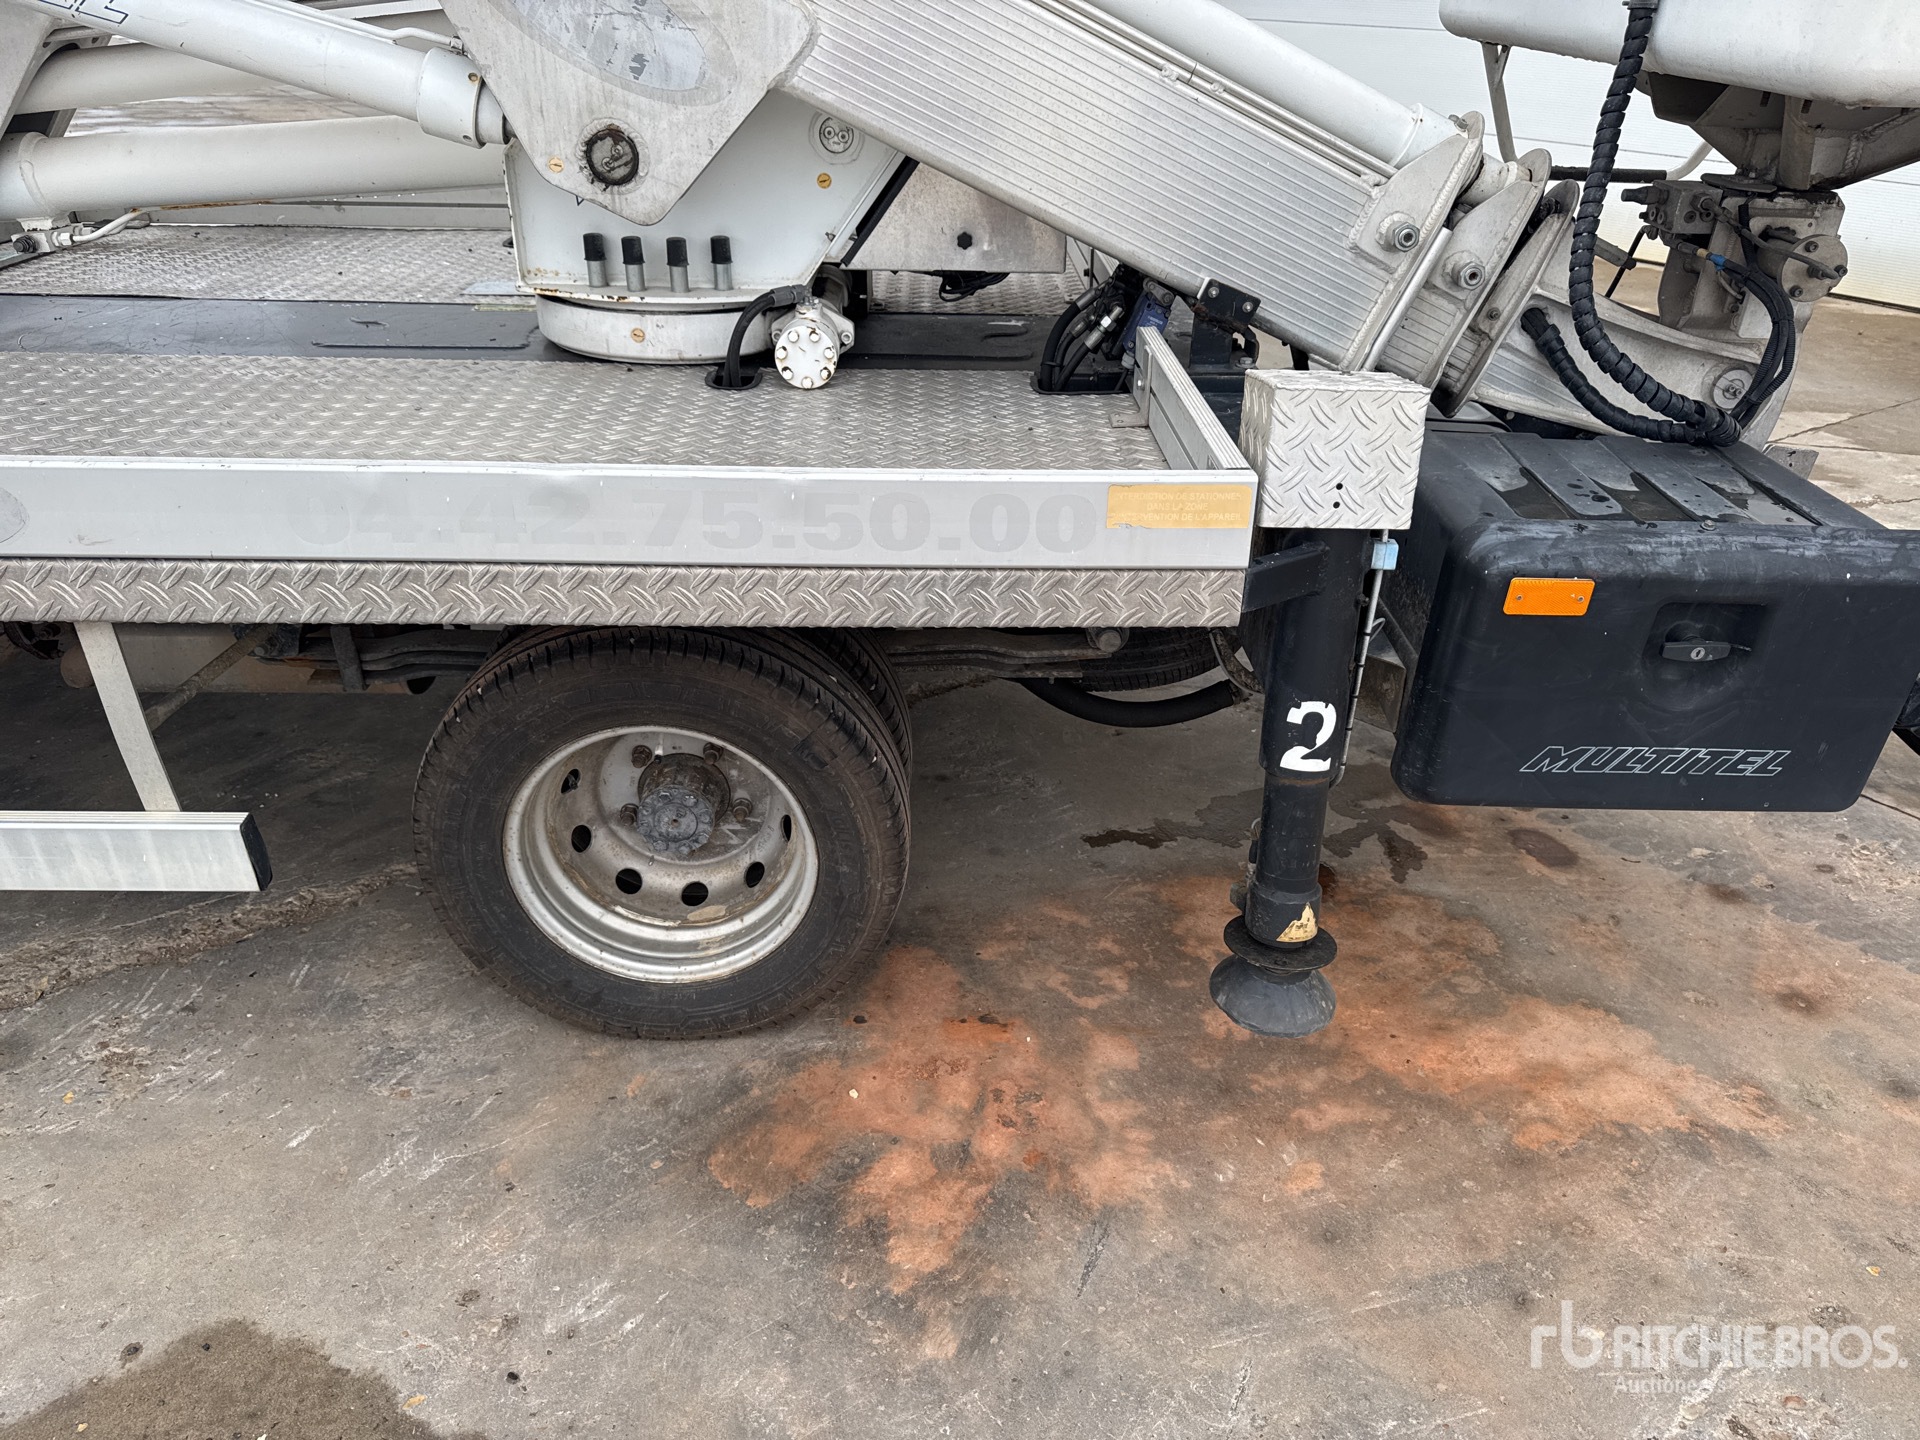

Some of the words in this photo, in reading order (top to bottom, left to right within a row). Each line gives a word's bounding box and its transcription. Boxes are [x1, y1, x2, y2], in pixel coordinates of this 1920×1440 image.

[1146, 502, 1170, 511] DANS
[1185, 502, 1209, 511] ZONE
[1181, 513, 1193, 521] DE
[1280, 701, 1336, 772] 2
[1519, 746, 1791, 776] MULTITEL
